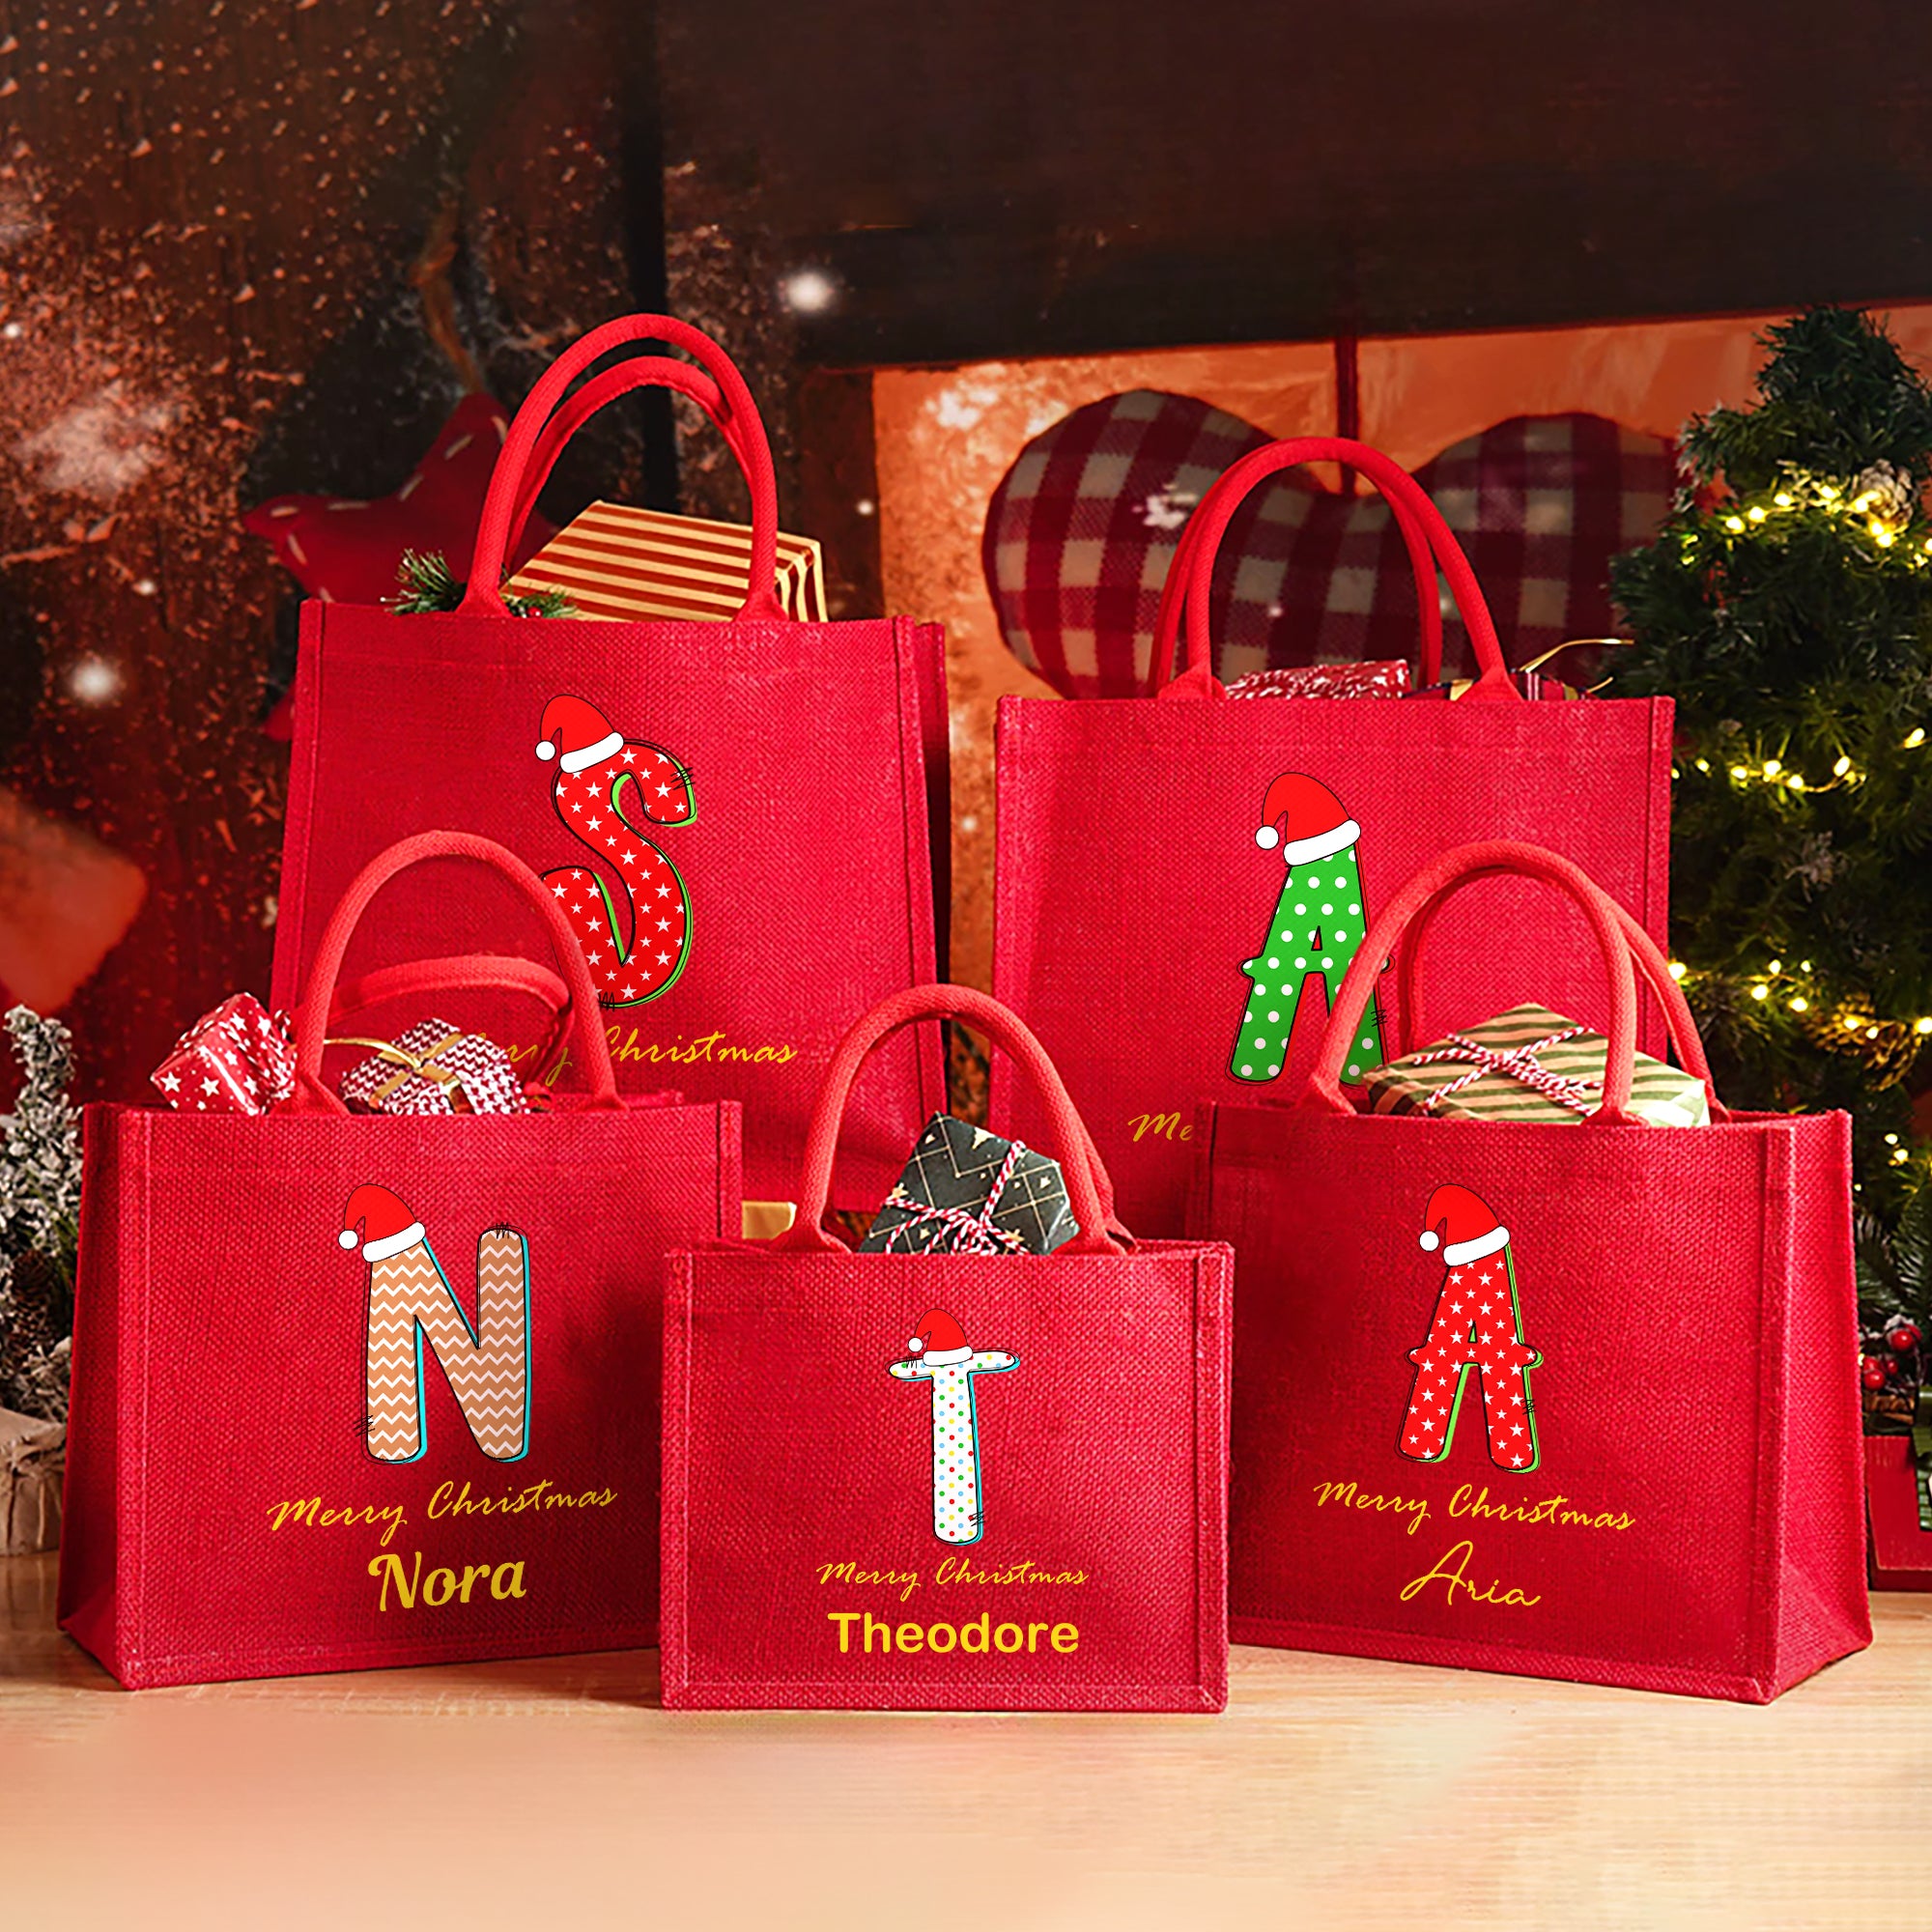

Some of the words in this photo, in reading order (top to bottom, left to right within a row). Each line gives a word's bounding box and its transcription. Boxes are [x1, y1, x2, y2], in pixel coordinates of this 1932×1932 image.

[540, 738, 698, 1009] S
[1226, 838, 1395, 1086] A
[358, 1223, 533, 1464] N
[1395, 1243, 1544, 1474] A
[886, 1348, 1021, 1546] T
[267, 1496, 408, 1548] Merry
[427, 1479, 618, 1520] Christmas
[1313, 1481, 1432, 1536] Merry
[1448, 1483, 1636, 1531] Christmas
[367, 1550, 527, 1612] Nora
[815, 1561, 922, 1603] Merry
[935, 1556, 1090, 1585] Christmas
[1400, 1540, 1542, 1607] Aria
[827, 1611, 1080, 1655] Theodore
